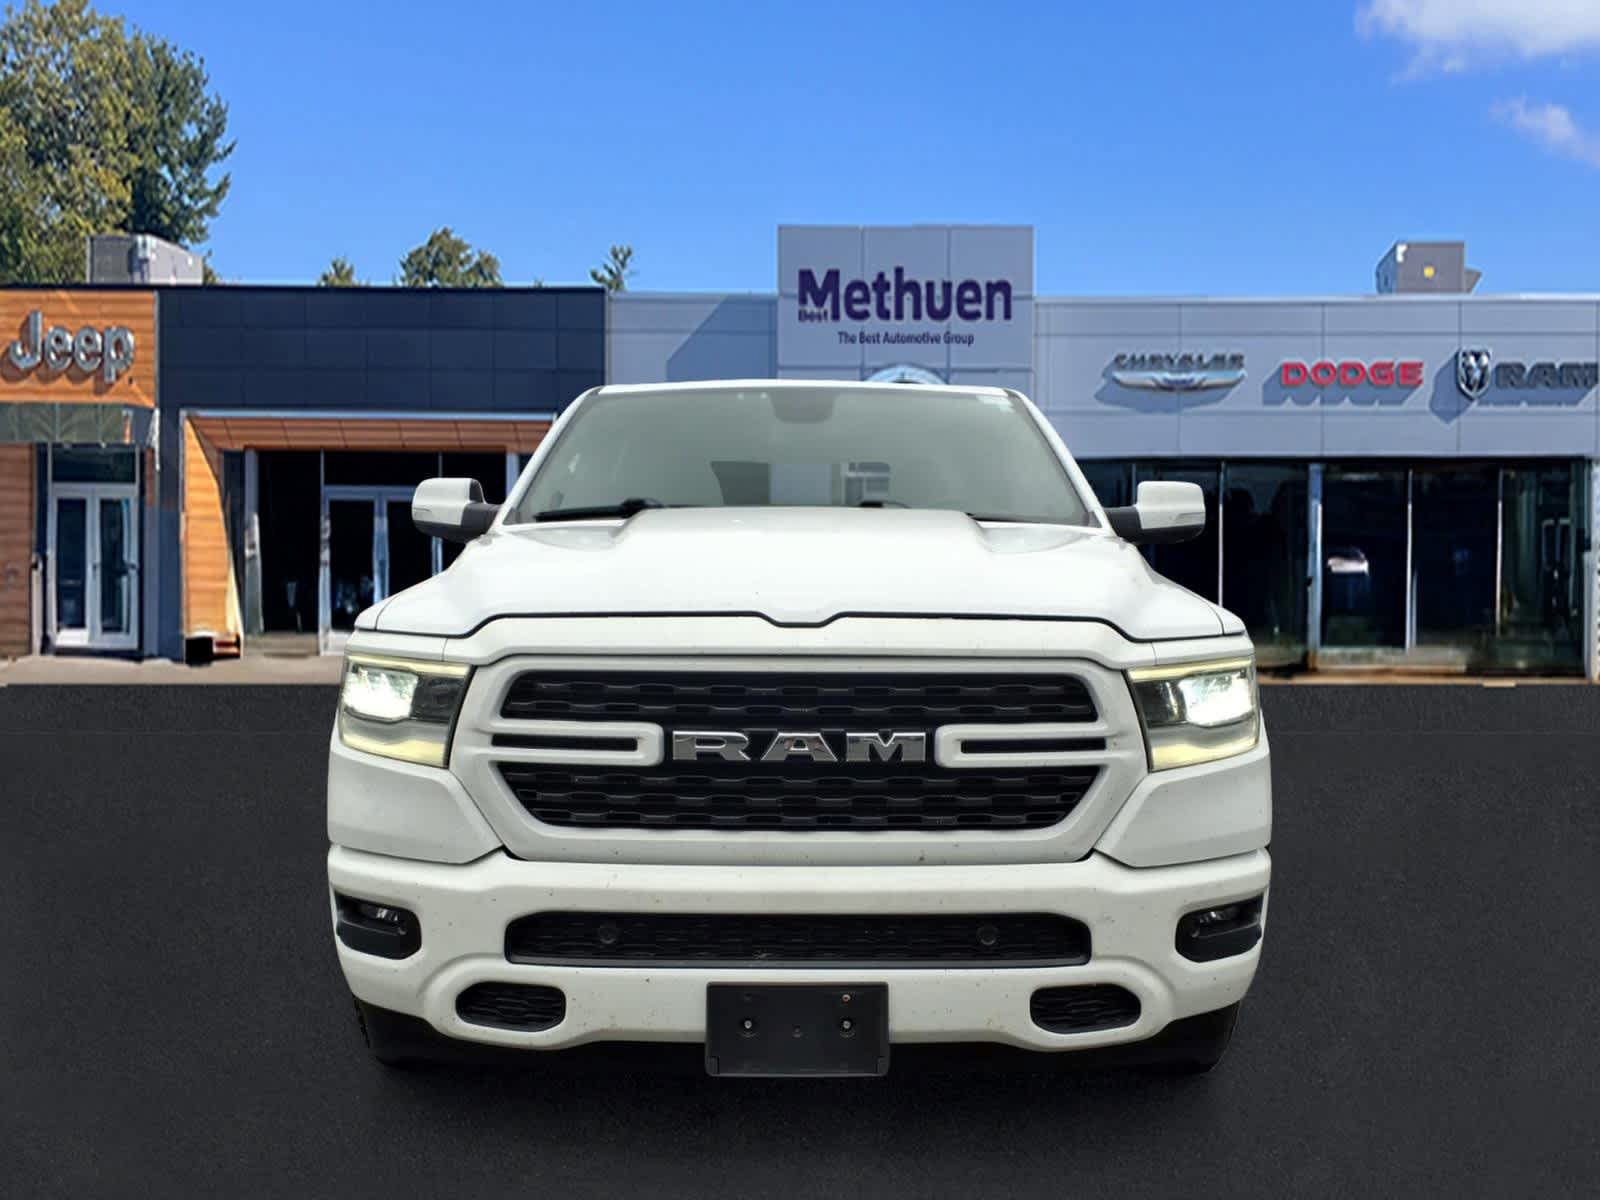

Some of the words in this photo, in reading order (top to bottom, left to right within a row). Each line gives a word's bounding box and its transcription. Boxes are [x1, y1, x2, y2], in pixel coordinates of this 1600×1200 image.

[798, 266, 1012, 322] Methuen
[9, 310, 135, 384] Jeep
[837, 331, 857, 345] The
[859, 331, 881, 345] Best
[883, 331, 941, 345] Automotive
[943, 331, 975, 346] Group
[1114, 353, 1246, 368] CHRYSLER
[1281, 361, 1424, 387] DODGE
[1496, 362, 1598, 389] RAM
[672, 730, 927, 763] RAM
